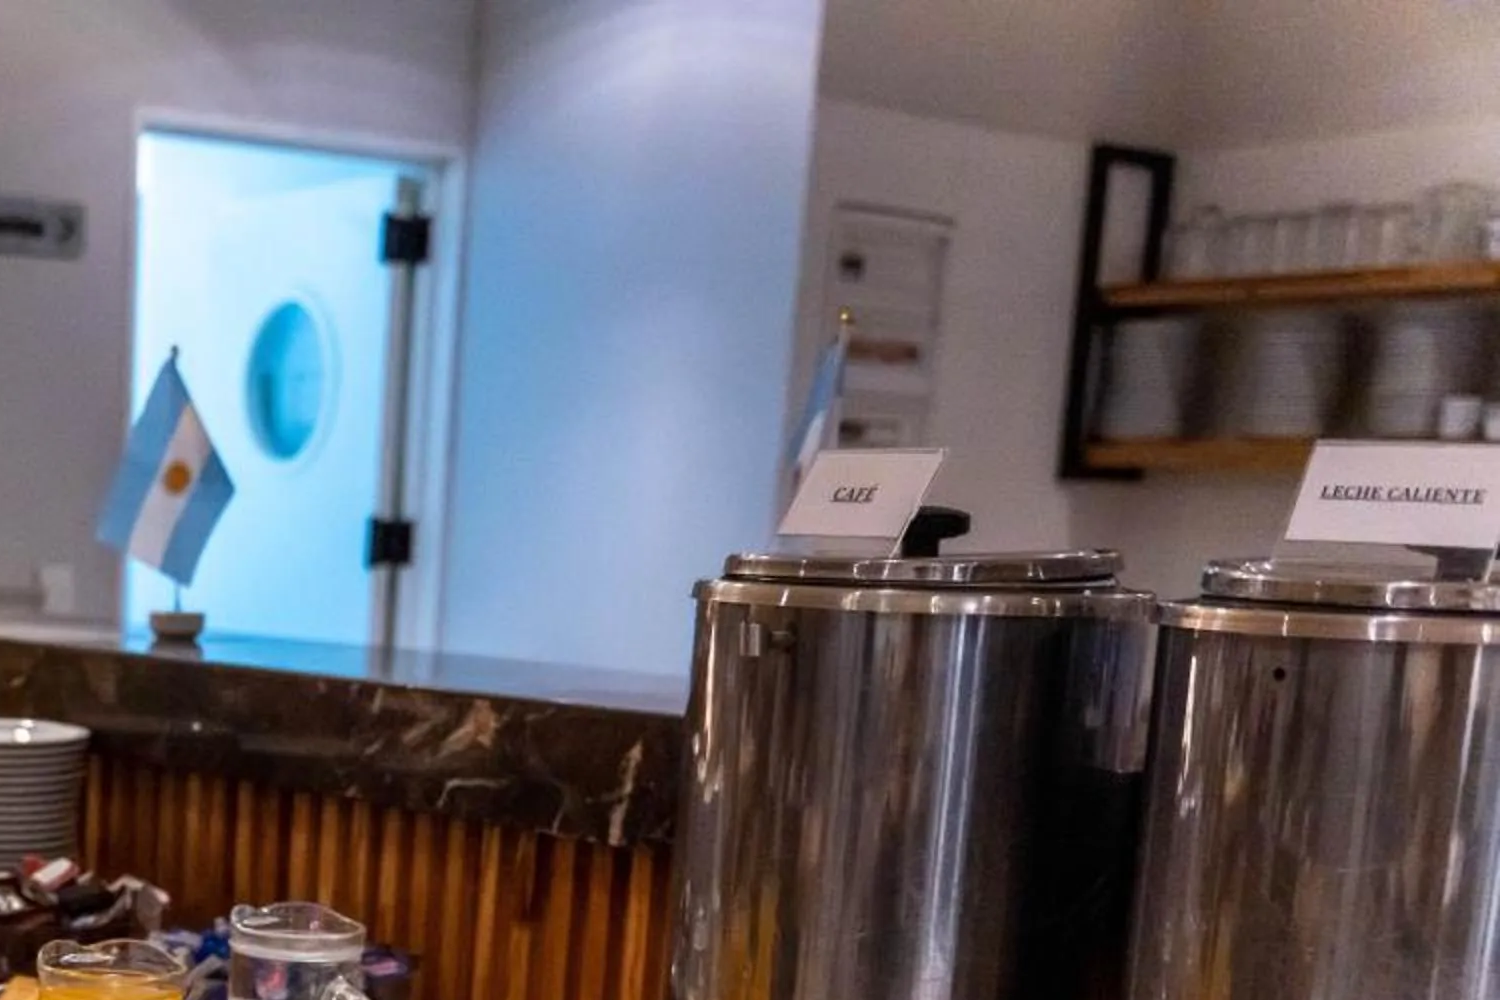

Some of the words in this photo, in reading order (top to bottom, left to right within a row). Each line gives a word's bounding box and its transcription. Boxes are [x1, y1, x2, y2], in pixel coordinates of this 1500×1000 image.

[831, 483, 879, 503] CAFÉ
[1320, 484, 1383, 501] LECHE
[1386, 486, 1487, 505] CALIENTE
